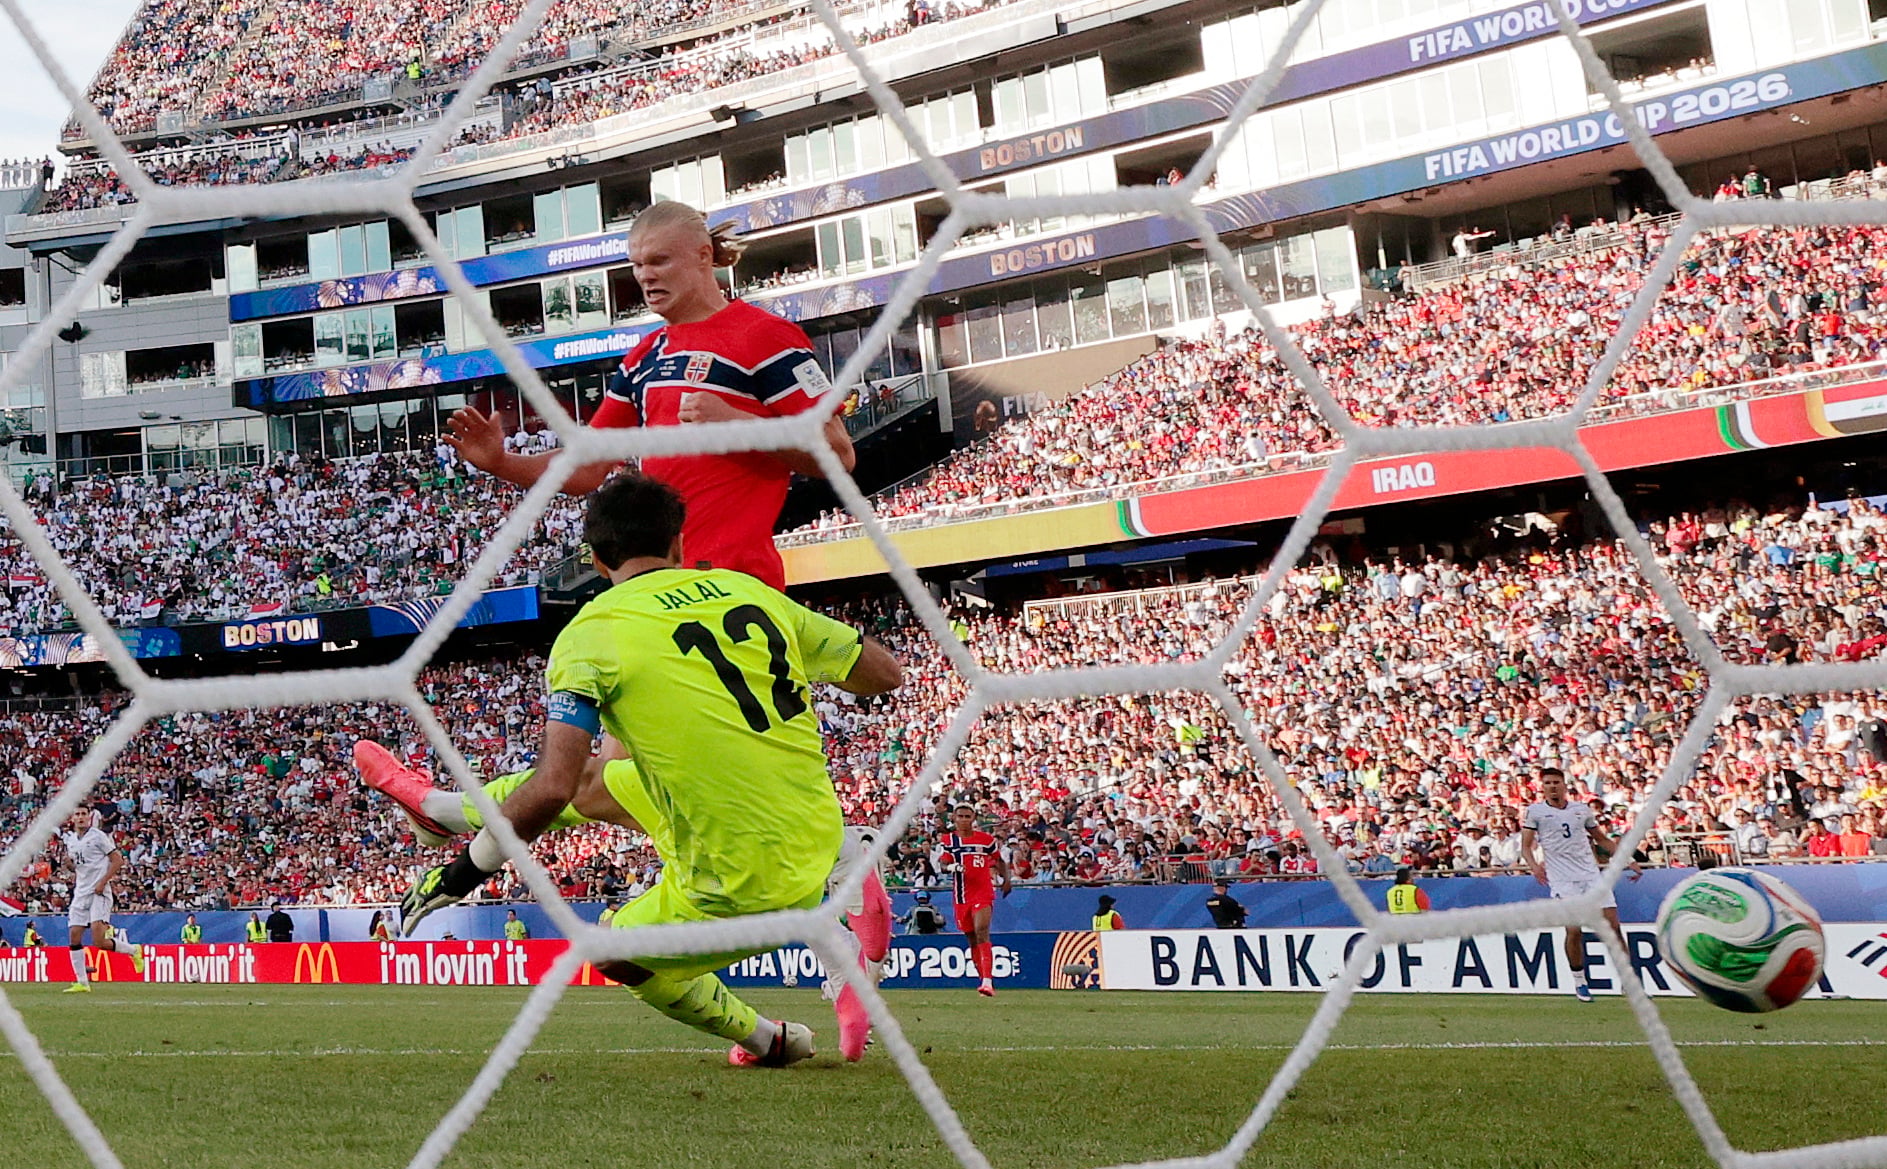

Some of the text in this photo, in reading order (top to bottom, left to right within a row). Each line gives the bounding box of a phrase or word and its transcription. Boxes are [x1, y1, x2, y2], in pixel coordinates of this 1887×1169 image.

[1409, 26, 1473, 62] FIFA
[1424, 145, 1489, 181] FIFA
[1490, 119, 1600, 164] WORLD
[1671, 73, 1790, 123] 2026
[980, 127, 1084, 170] BOSTON
[547, 239, 630, 267] #FIFAWorldCu
[990, 234, 1096, 276] BOSTON
[1372, 461, 1436, 493] IRAQ
[653, 579, 732, 610] JALAL
[224, 618, 319, 647] BOSTON
[672, 604, 808, 733] 12
[1561, 822, 1572, 839] 3
[0, 946, 49, 982] vin' it
[144, 943, 256, 983] i'm lovin' it
[380, 940, 529, 985] i'm lovin' it
[883, 947, 917, 978] UP
[1150, 930, 1834, 993] BANK OF AMER
